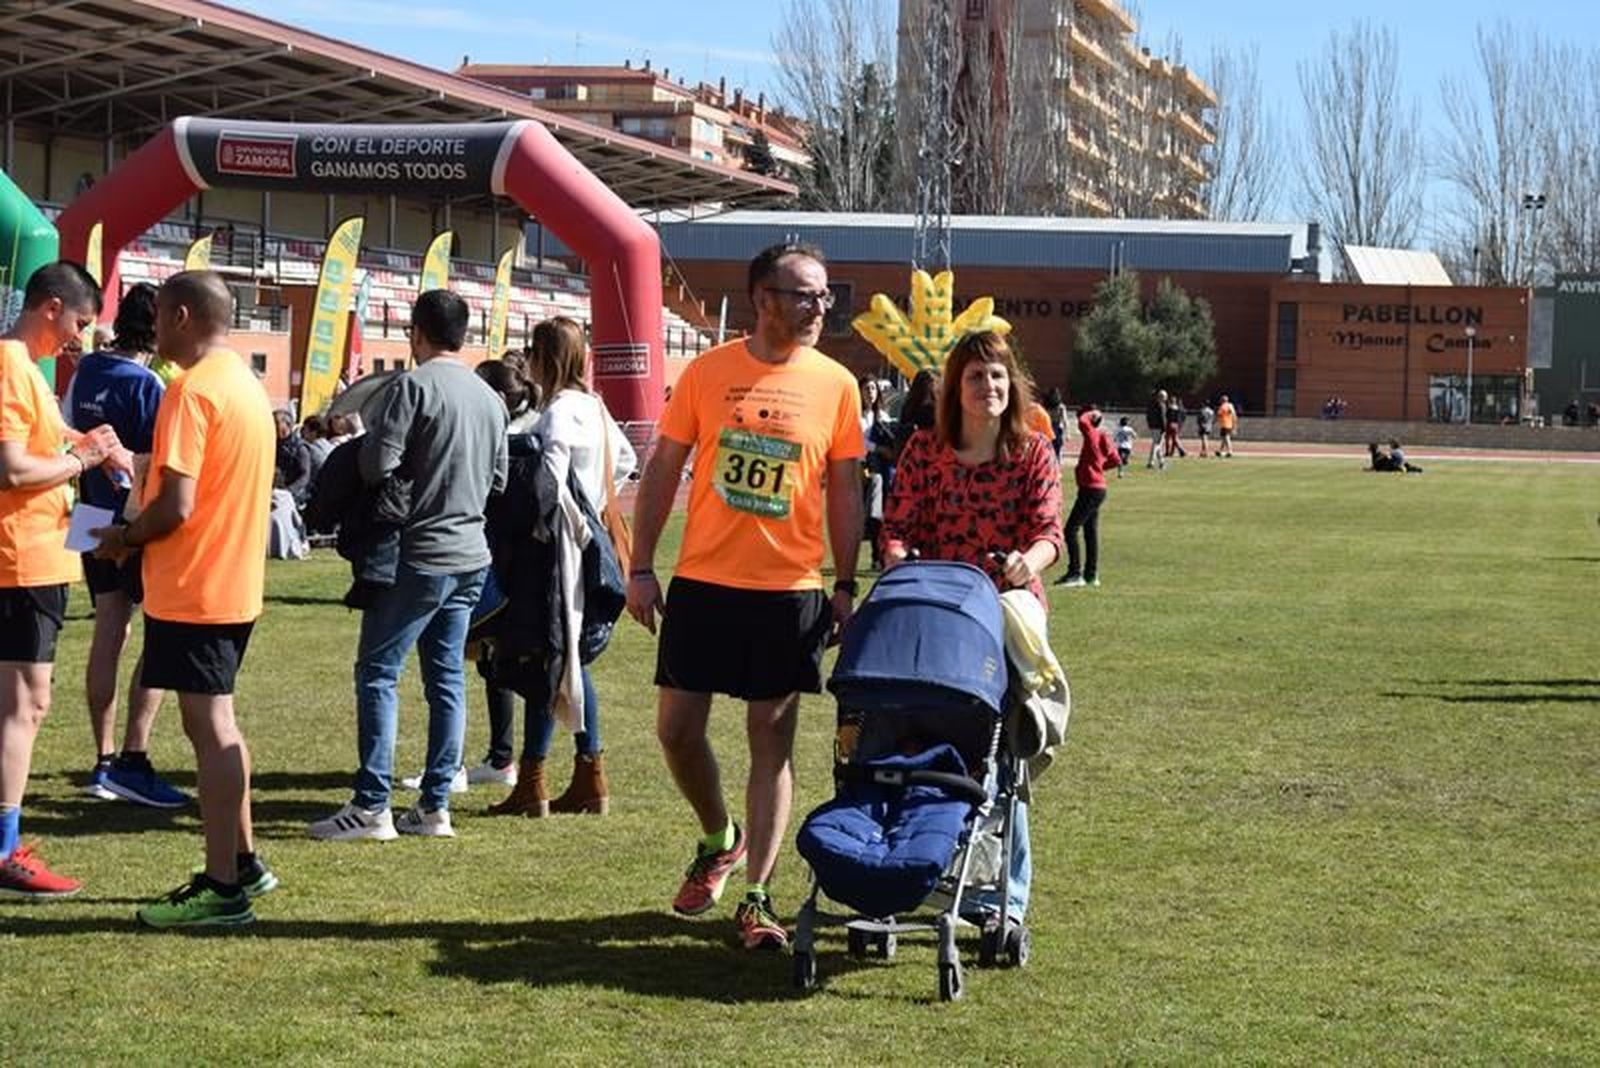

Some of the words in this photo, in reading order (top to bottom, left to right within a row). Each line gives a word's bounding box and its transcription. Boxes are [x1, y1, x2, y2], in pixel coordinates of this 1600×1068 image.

[311, 136, 350, 154] CON
[355, 137, 377, 154] EL
[381, 138, 466, 155] DEPORTE
[234, 153, 290, 169] ZAMORA
[311, 160, 400, 179] GANAMOS
[403, 162, 467, 180] TODOS
[1344, 303, 1483, 324] PABELLON
[723, 453, 785, 494] 361
